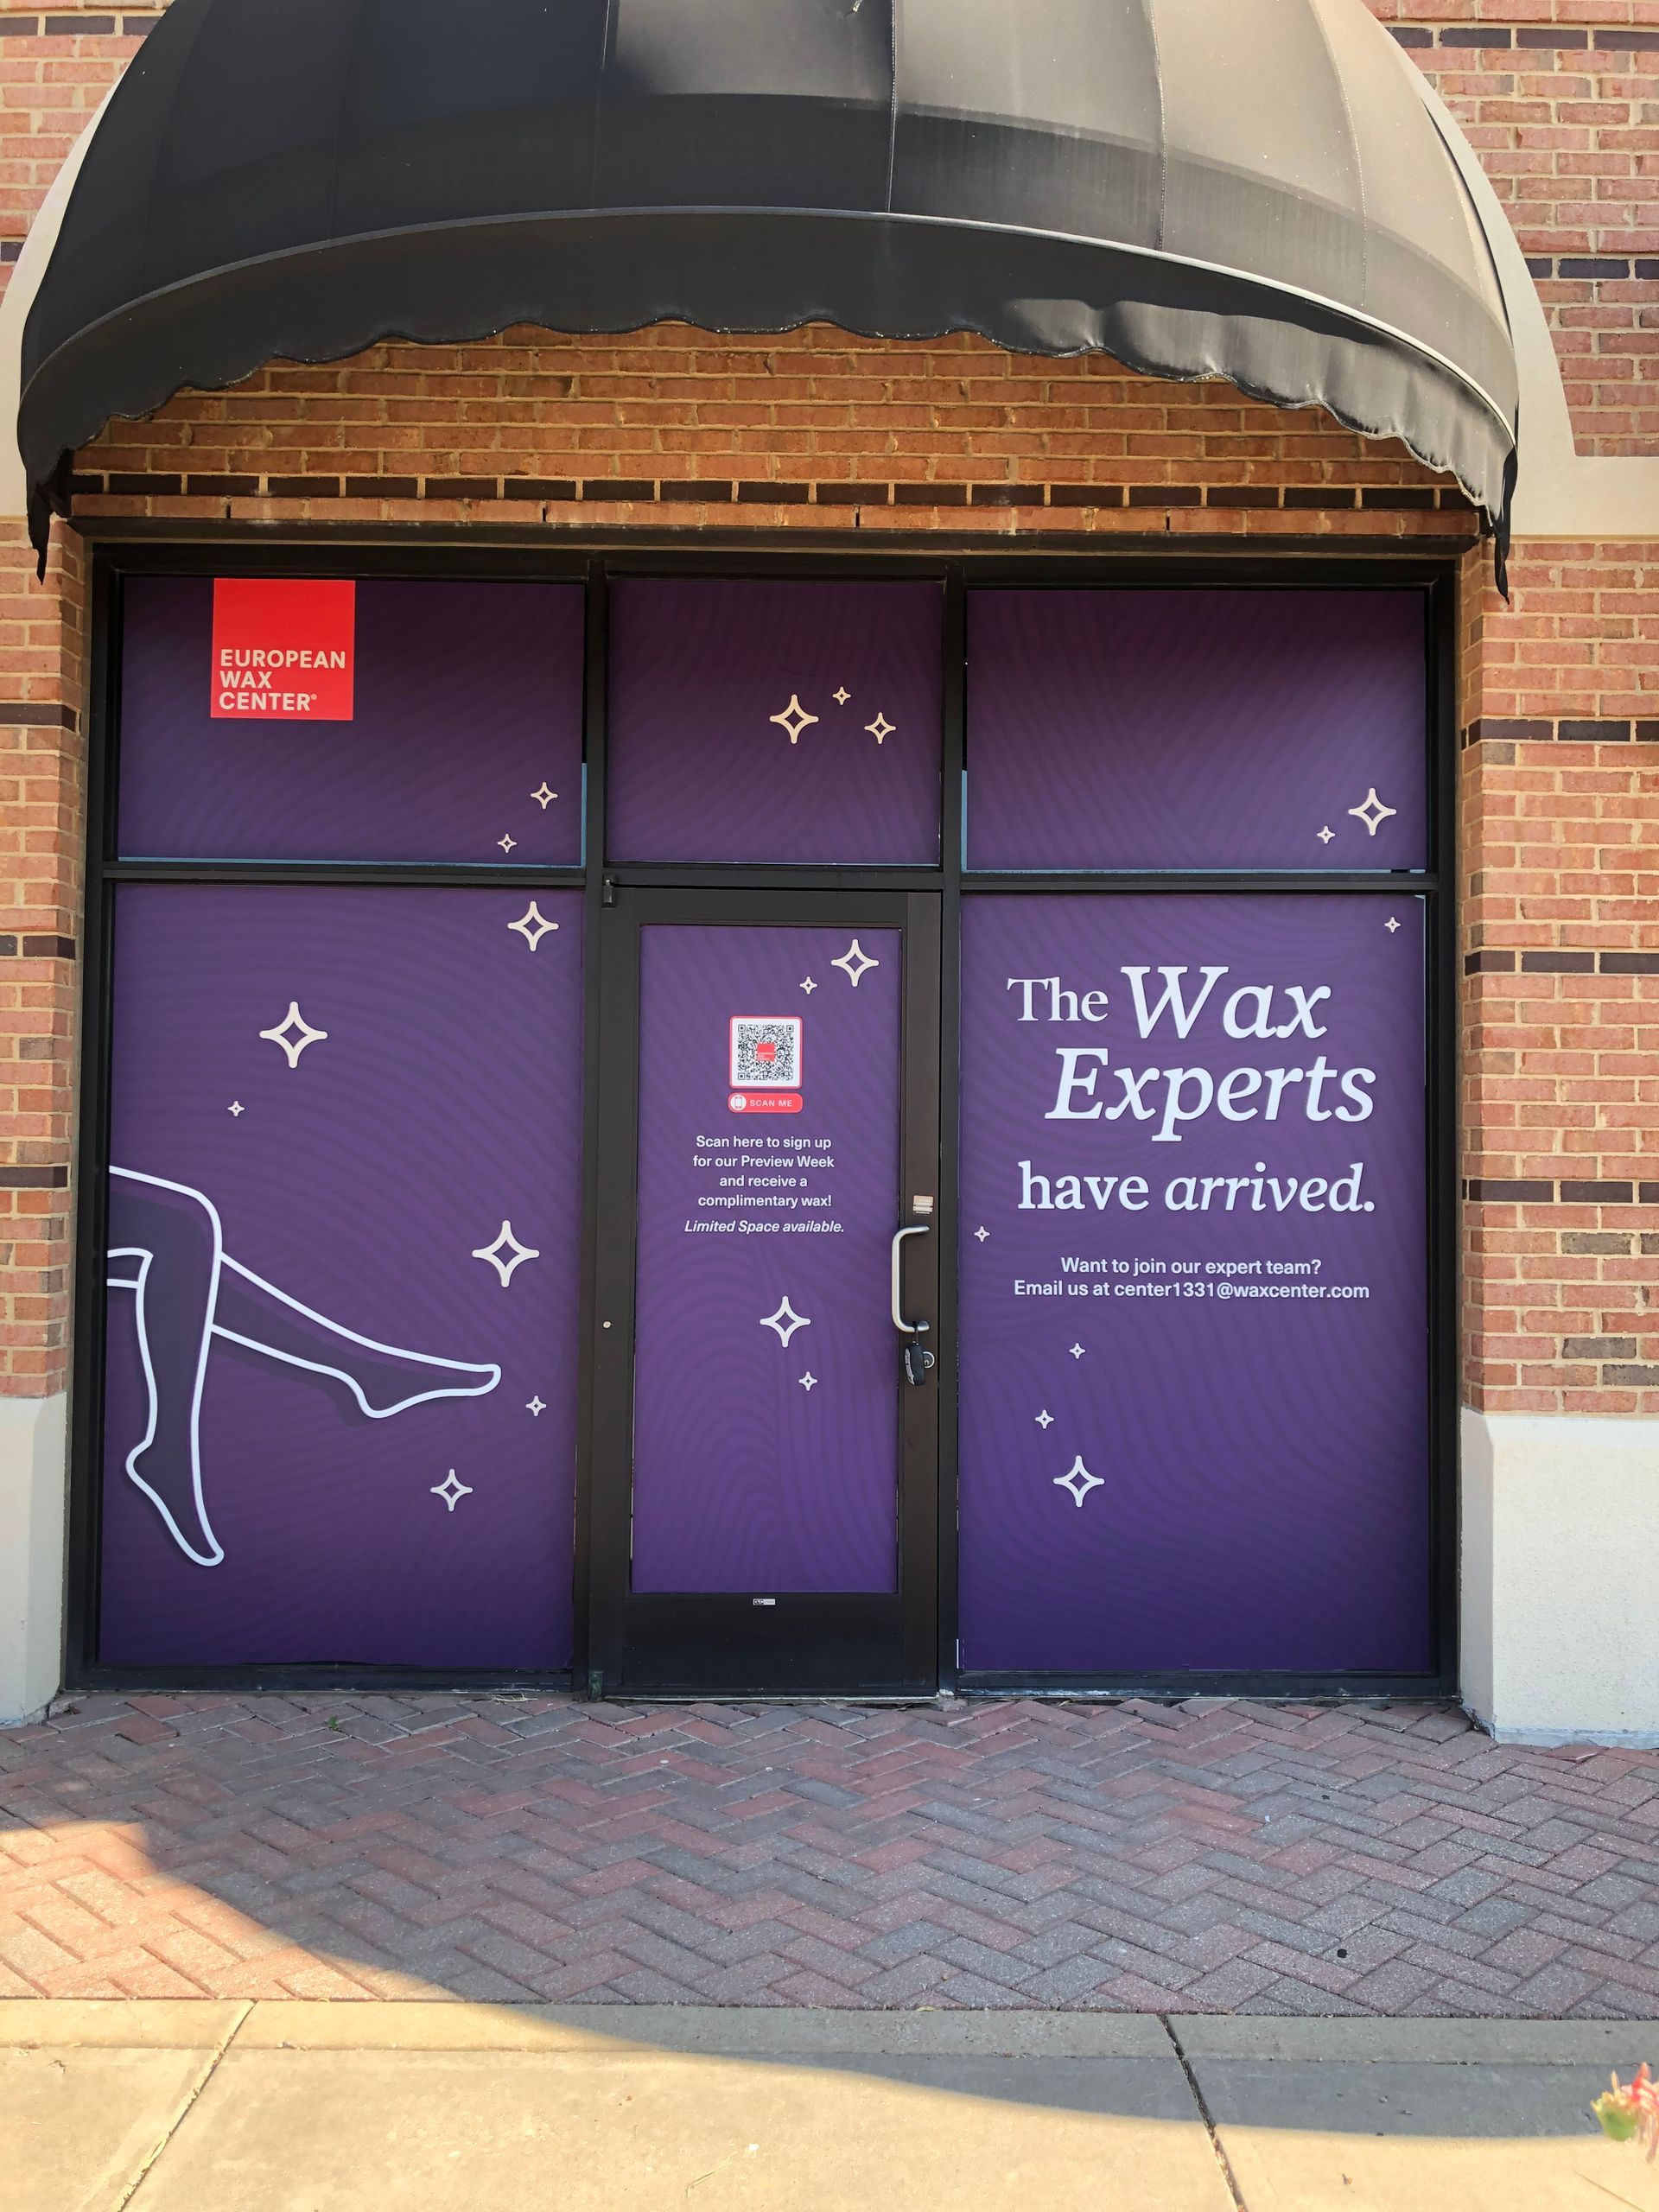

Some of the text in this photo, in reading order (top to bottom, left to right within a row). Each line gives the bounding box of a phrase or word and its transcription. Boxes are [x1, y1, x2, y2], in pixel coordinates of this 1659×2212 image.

[220, 648, 346, 668] EUROPEAN
[219, 670, 272, 689] WAX
[1007, 966, 1332, 1039] The Wax
[1044, 1047, 1376, 1141] Experts
[696, 1135, 832, 1150] Scan here to sign up
[692, 1154, 835, 1167] for our Preview Week
[719, 1174, 808, 1186] and receive a
[1017, 1160, 1376, 1211] have arrived.
[697, 1194, 832, 1209] complimentary wax!
[683, 1219, 844, 1234] Limited Space available.
[1060, 1256, 1322, 1277] Want to join our expert team?
[1014, 1279, 1370, 1299] Email us at center1331@waxcenter.com
